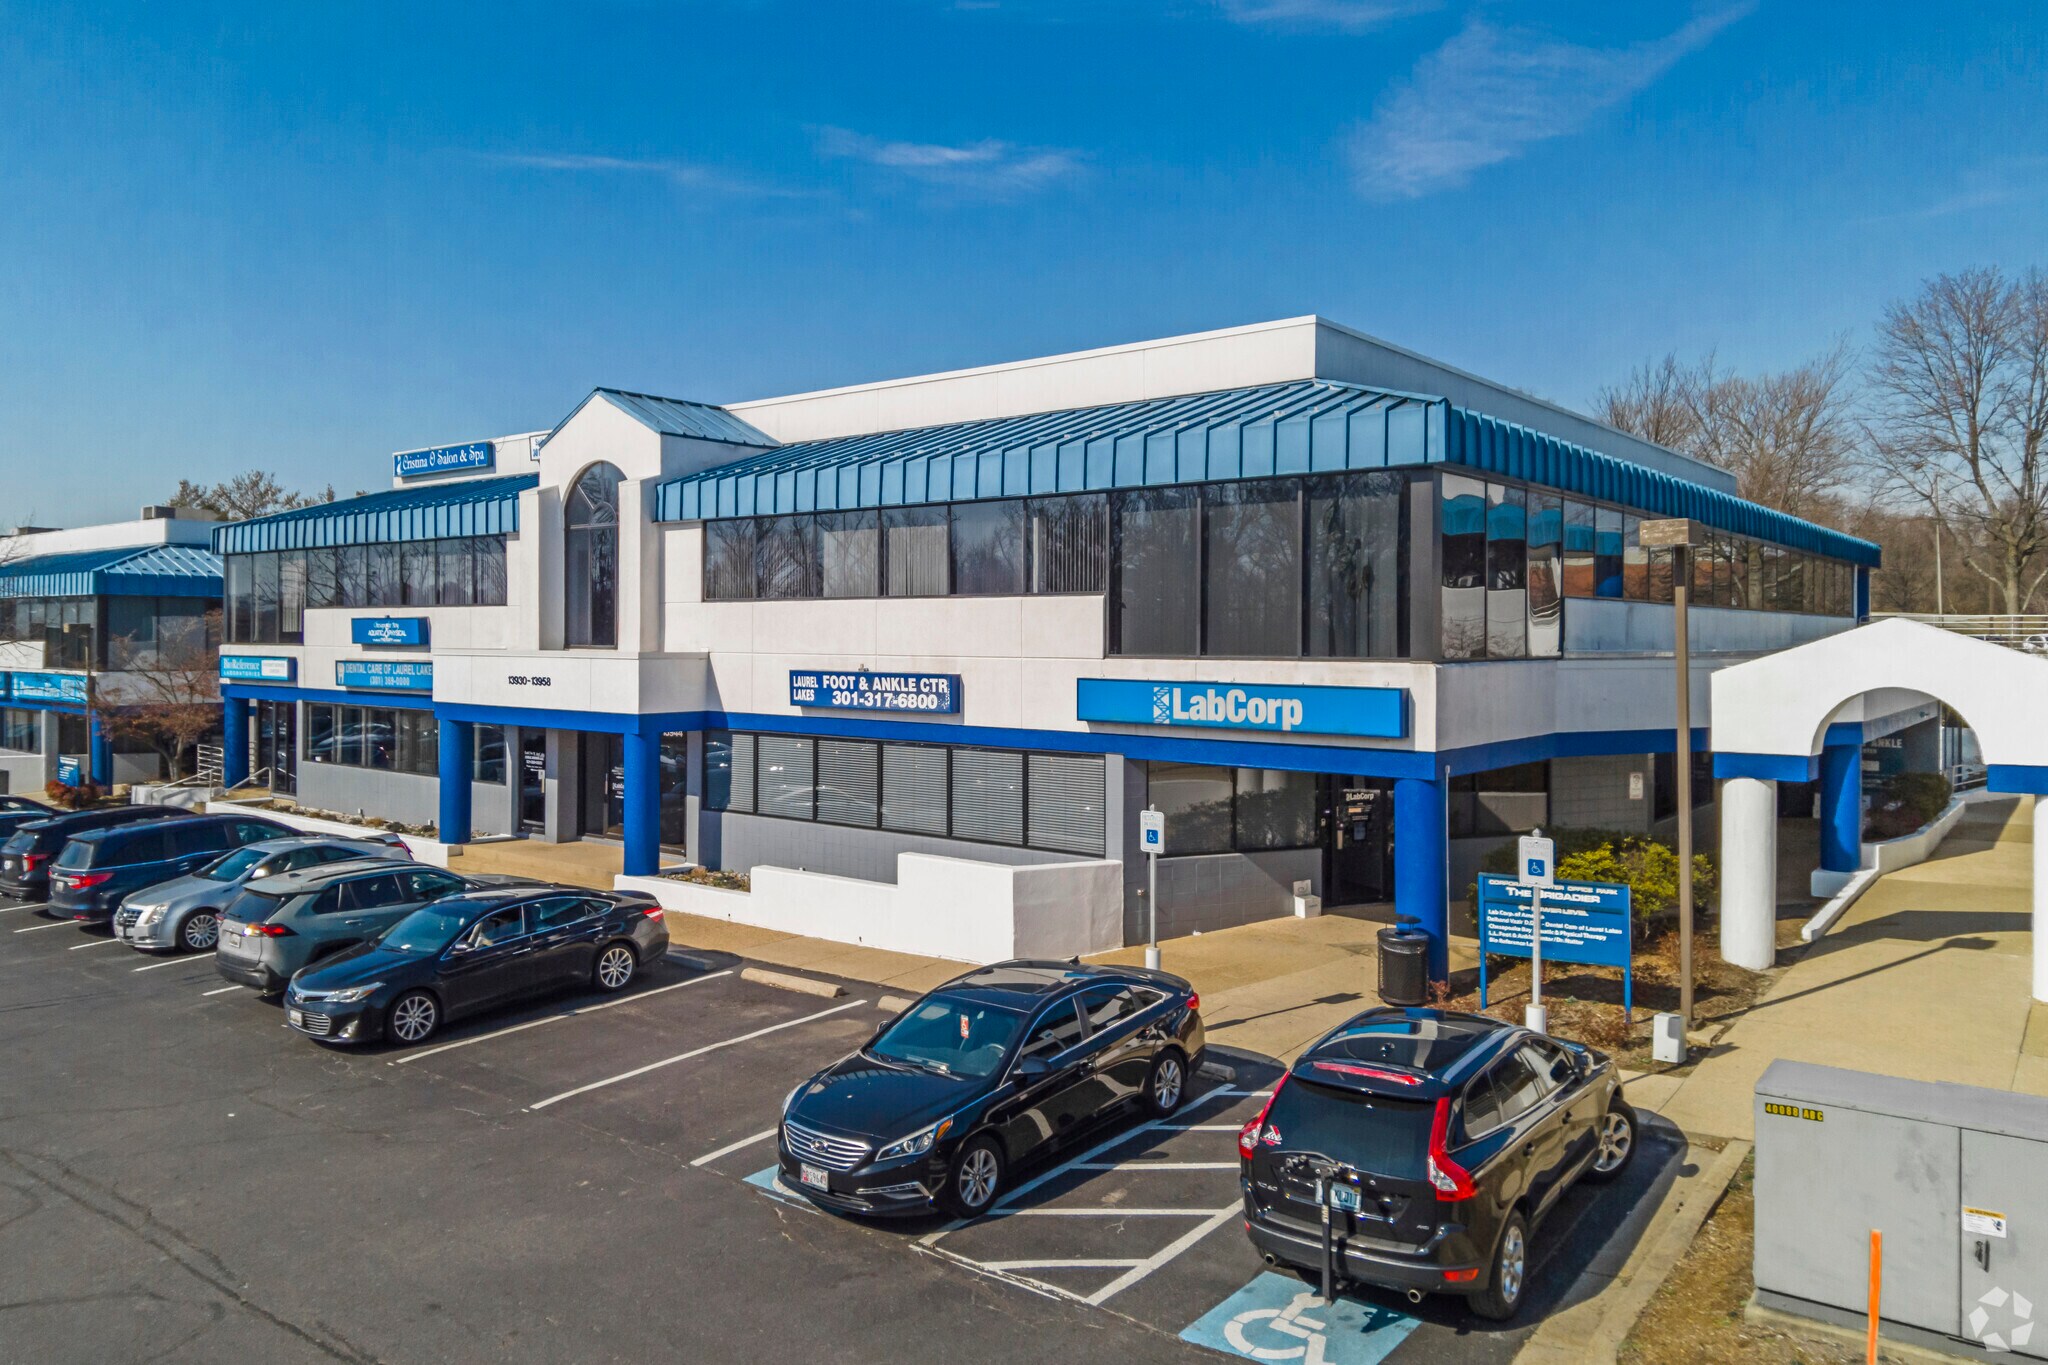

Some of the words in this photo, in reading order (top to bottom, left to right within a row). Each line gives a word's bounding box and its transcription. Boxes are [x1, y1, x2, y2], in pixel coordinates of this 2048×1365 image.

[402, 455, 428, 470] Cristina
[437, 449, 459, 465] Salon
[460, 449, 467, 463] &
[469, 445, 485, 466] Spa
[345, 663, 367, 674] DENTAL
[367, 663, 382, 675] CARE
[384, 664, 391, 675] OF
[392, 663, 415, 676] LAUREL
[416, 664, 433, 676] LAKE
[793, 676, 819, 689] LAUREL
[822, 675, 856, 690] FOOT
[858, 676, 869, 691] &
[872, 676, 917, 692] ANKLE
[919, 678, 948, 693] CTR
[793, 689, 815, 701] LAKES
[832, 690, 938, 709] 301-317-6800
[1172, 687, 1303, 731] LabCorp
[1871, 738, 1903, 748] ANKLE
[1350, 792, 1374, 801] LabCorp
[1505, 886, 1532, 898] THE
[1595, 887, 1618, 895] PARK
[1521, 926, 1533, 934] Bay
[1560, 930, 1583, 938] Physical
[1583, 932, 1607, 941] Therapy
